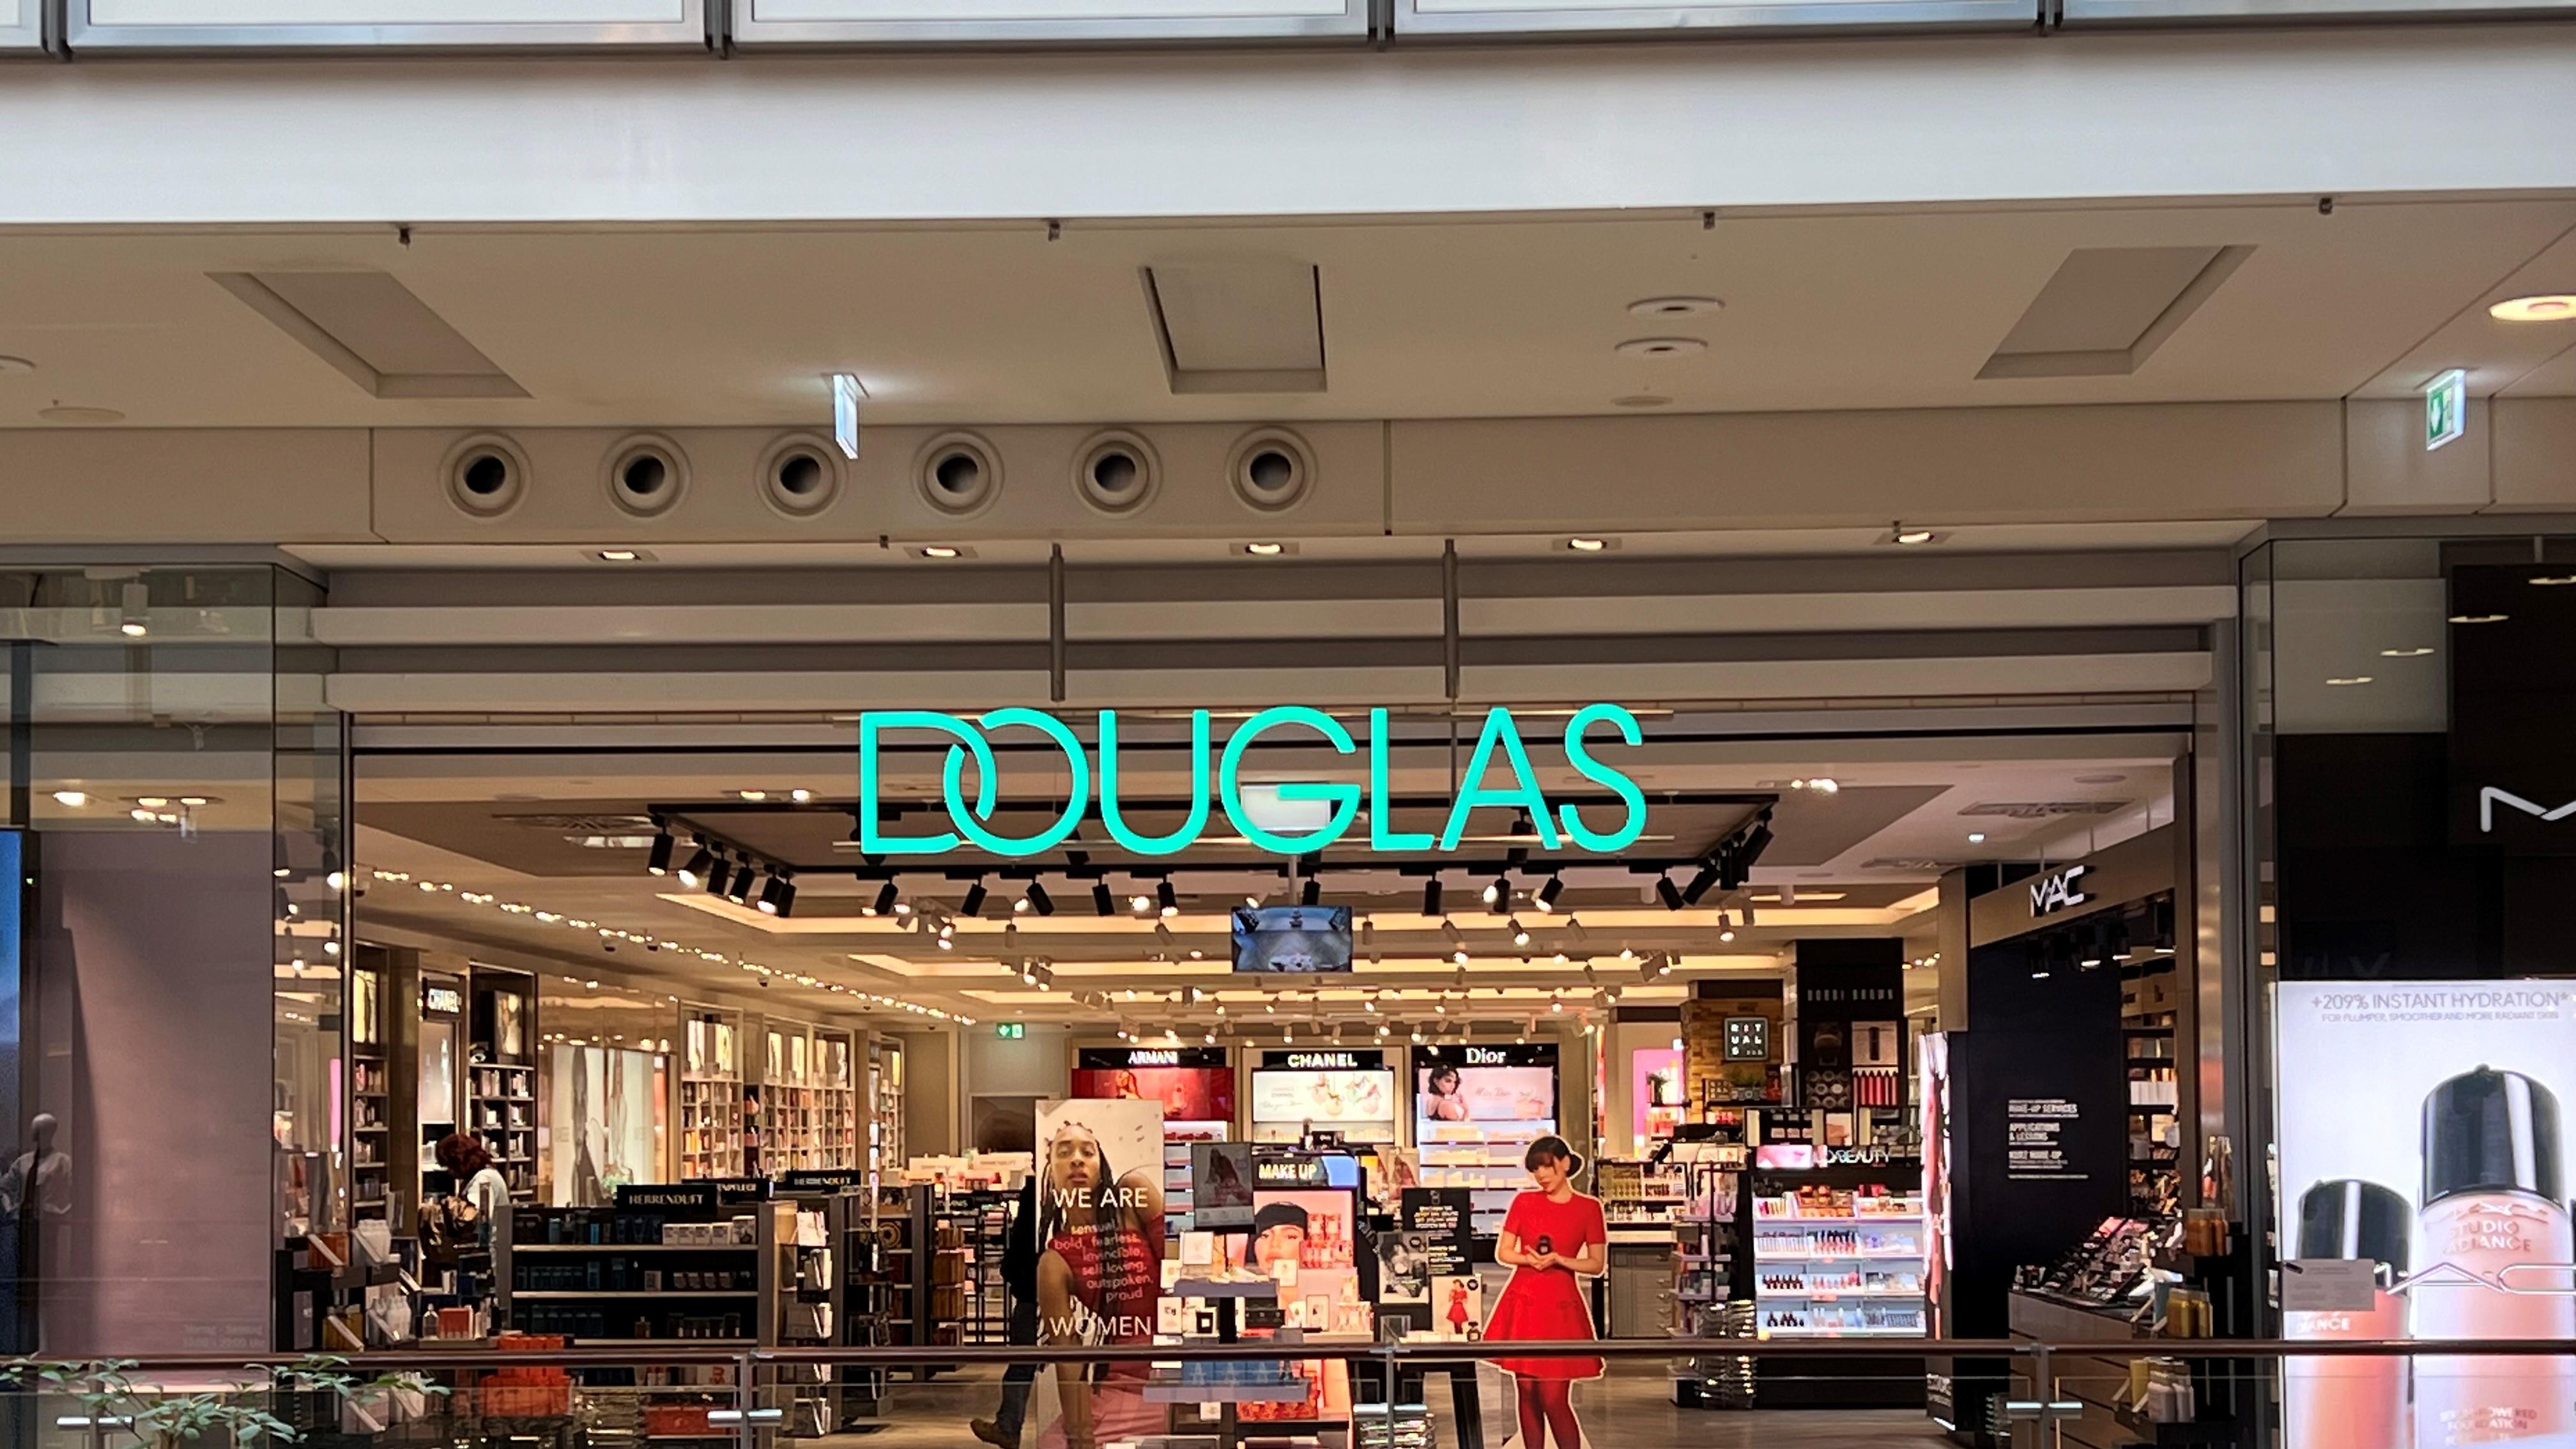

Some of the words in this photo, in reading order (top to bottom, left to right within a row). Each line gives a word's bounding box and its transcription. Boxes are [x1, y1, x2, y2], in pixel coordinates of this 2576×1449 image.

[860, 703, 1647, 856] DOUGLAS
[2030, 864, 2085, 917] MAC
[2311, 993, 2370, 1009] +209%
[2373, 993, 2448, 1008] INSTANT
[1128, 1050, 1177, 1064] ARMANI
[1287, 1053, 1358, 1068] CHANEL
[1465, 1048, 1506, 1064] Dior
[1258, 1163, 1296, 1179] MAKE
[1298, 1163, 1317, 1180] UP
[1053, 1187, 1092, 1208] WE
[1100, 1187, 1149, 1208] ARE
[1106, 1288, 1143, 1303] proud
[1050, 1315, 1151, 1337] WOMEN
